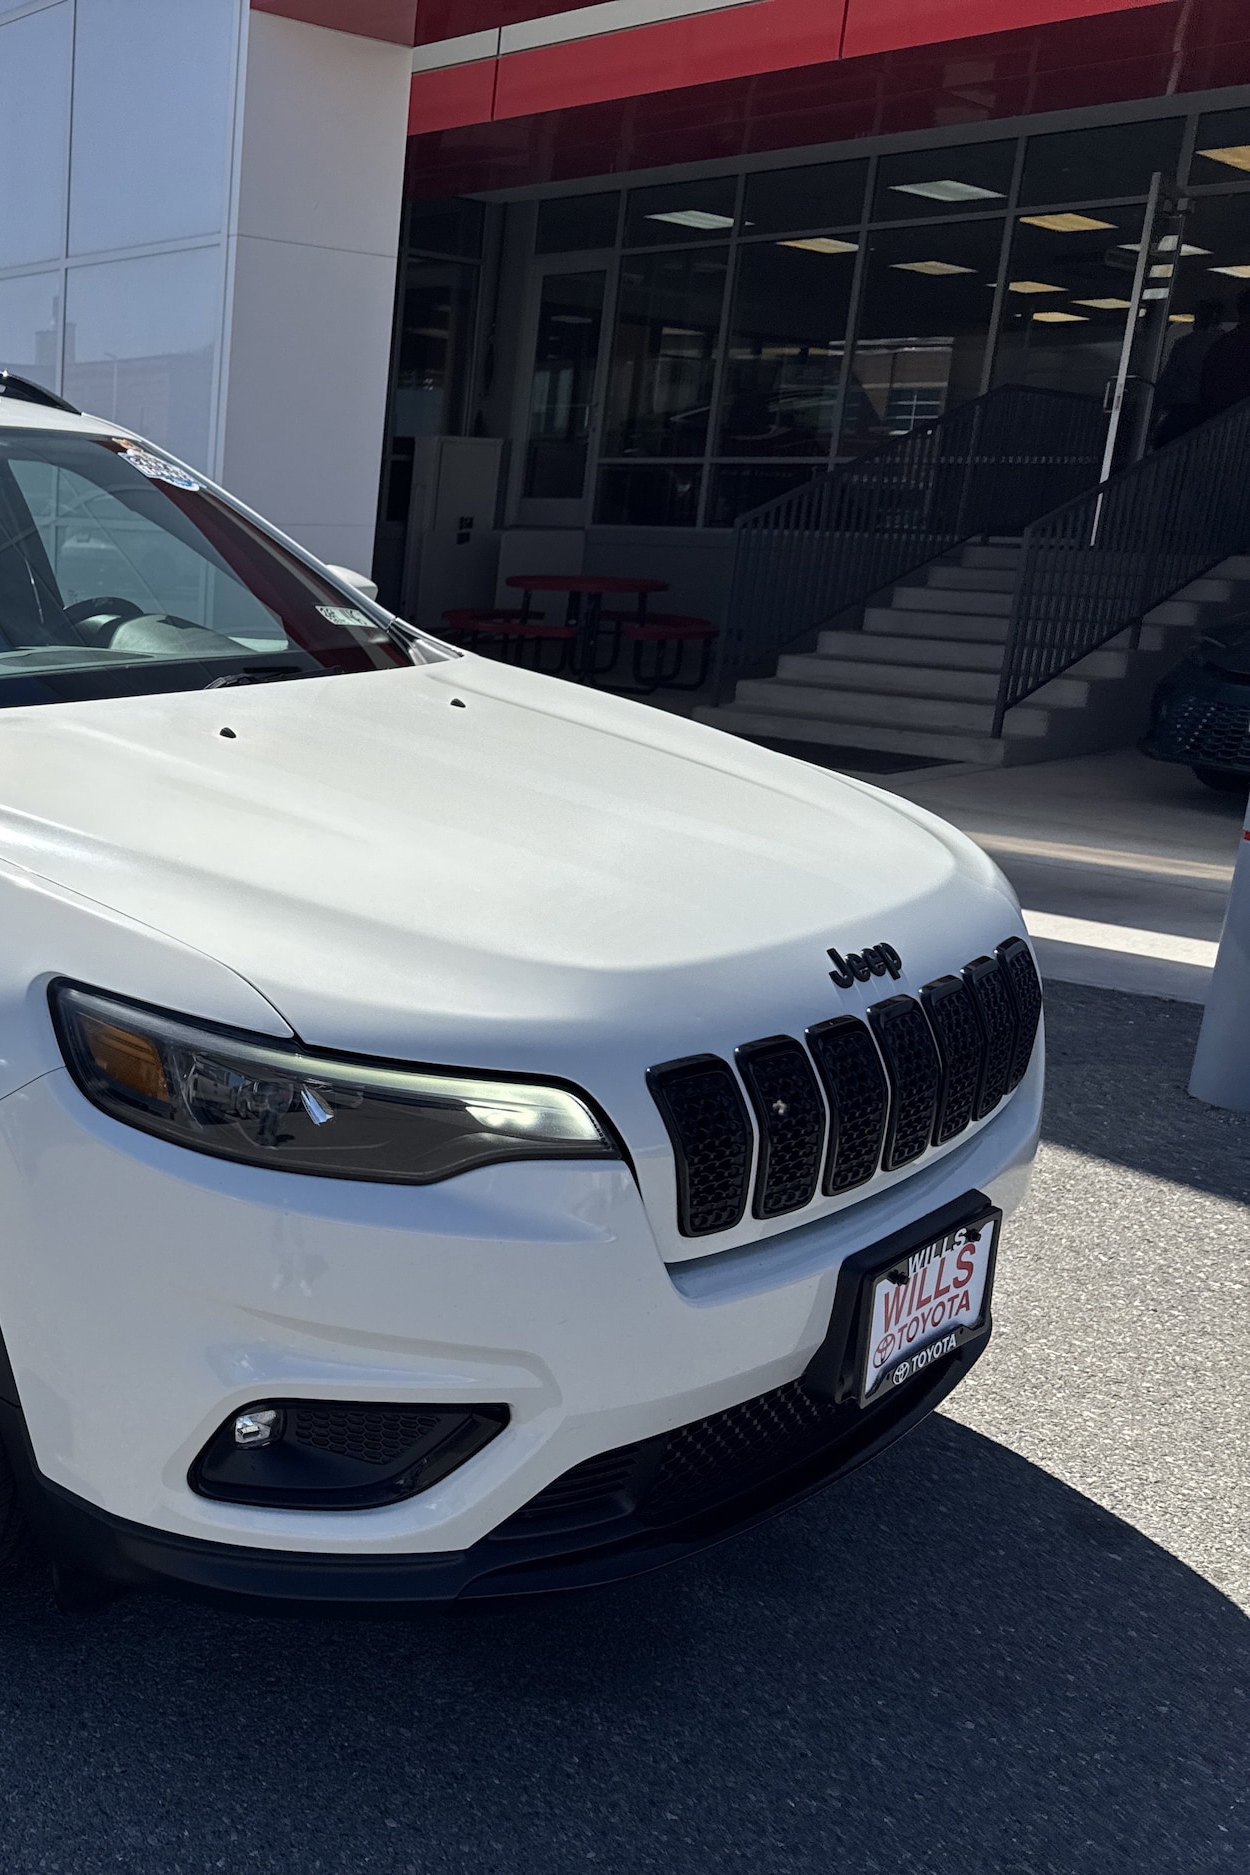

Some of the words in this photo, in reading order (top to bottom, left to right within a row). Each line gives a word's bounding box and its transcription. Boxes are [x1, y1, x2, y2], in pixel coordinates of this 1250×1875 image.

[826, 942, 902, 989] Jeep
[908, 1227, 967, 1276] WILLS
[884, 1243, 976, 1333] WILLS
[897, 1290, 970, 1350] TOYOTA
[911, 1333, 957, 1373] TOYOTA
